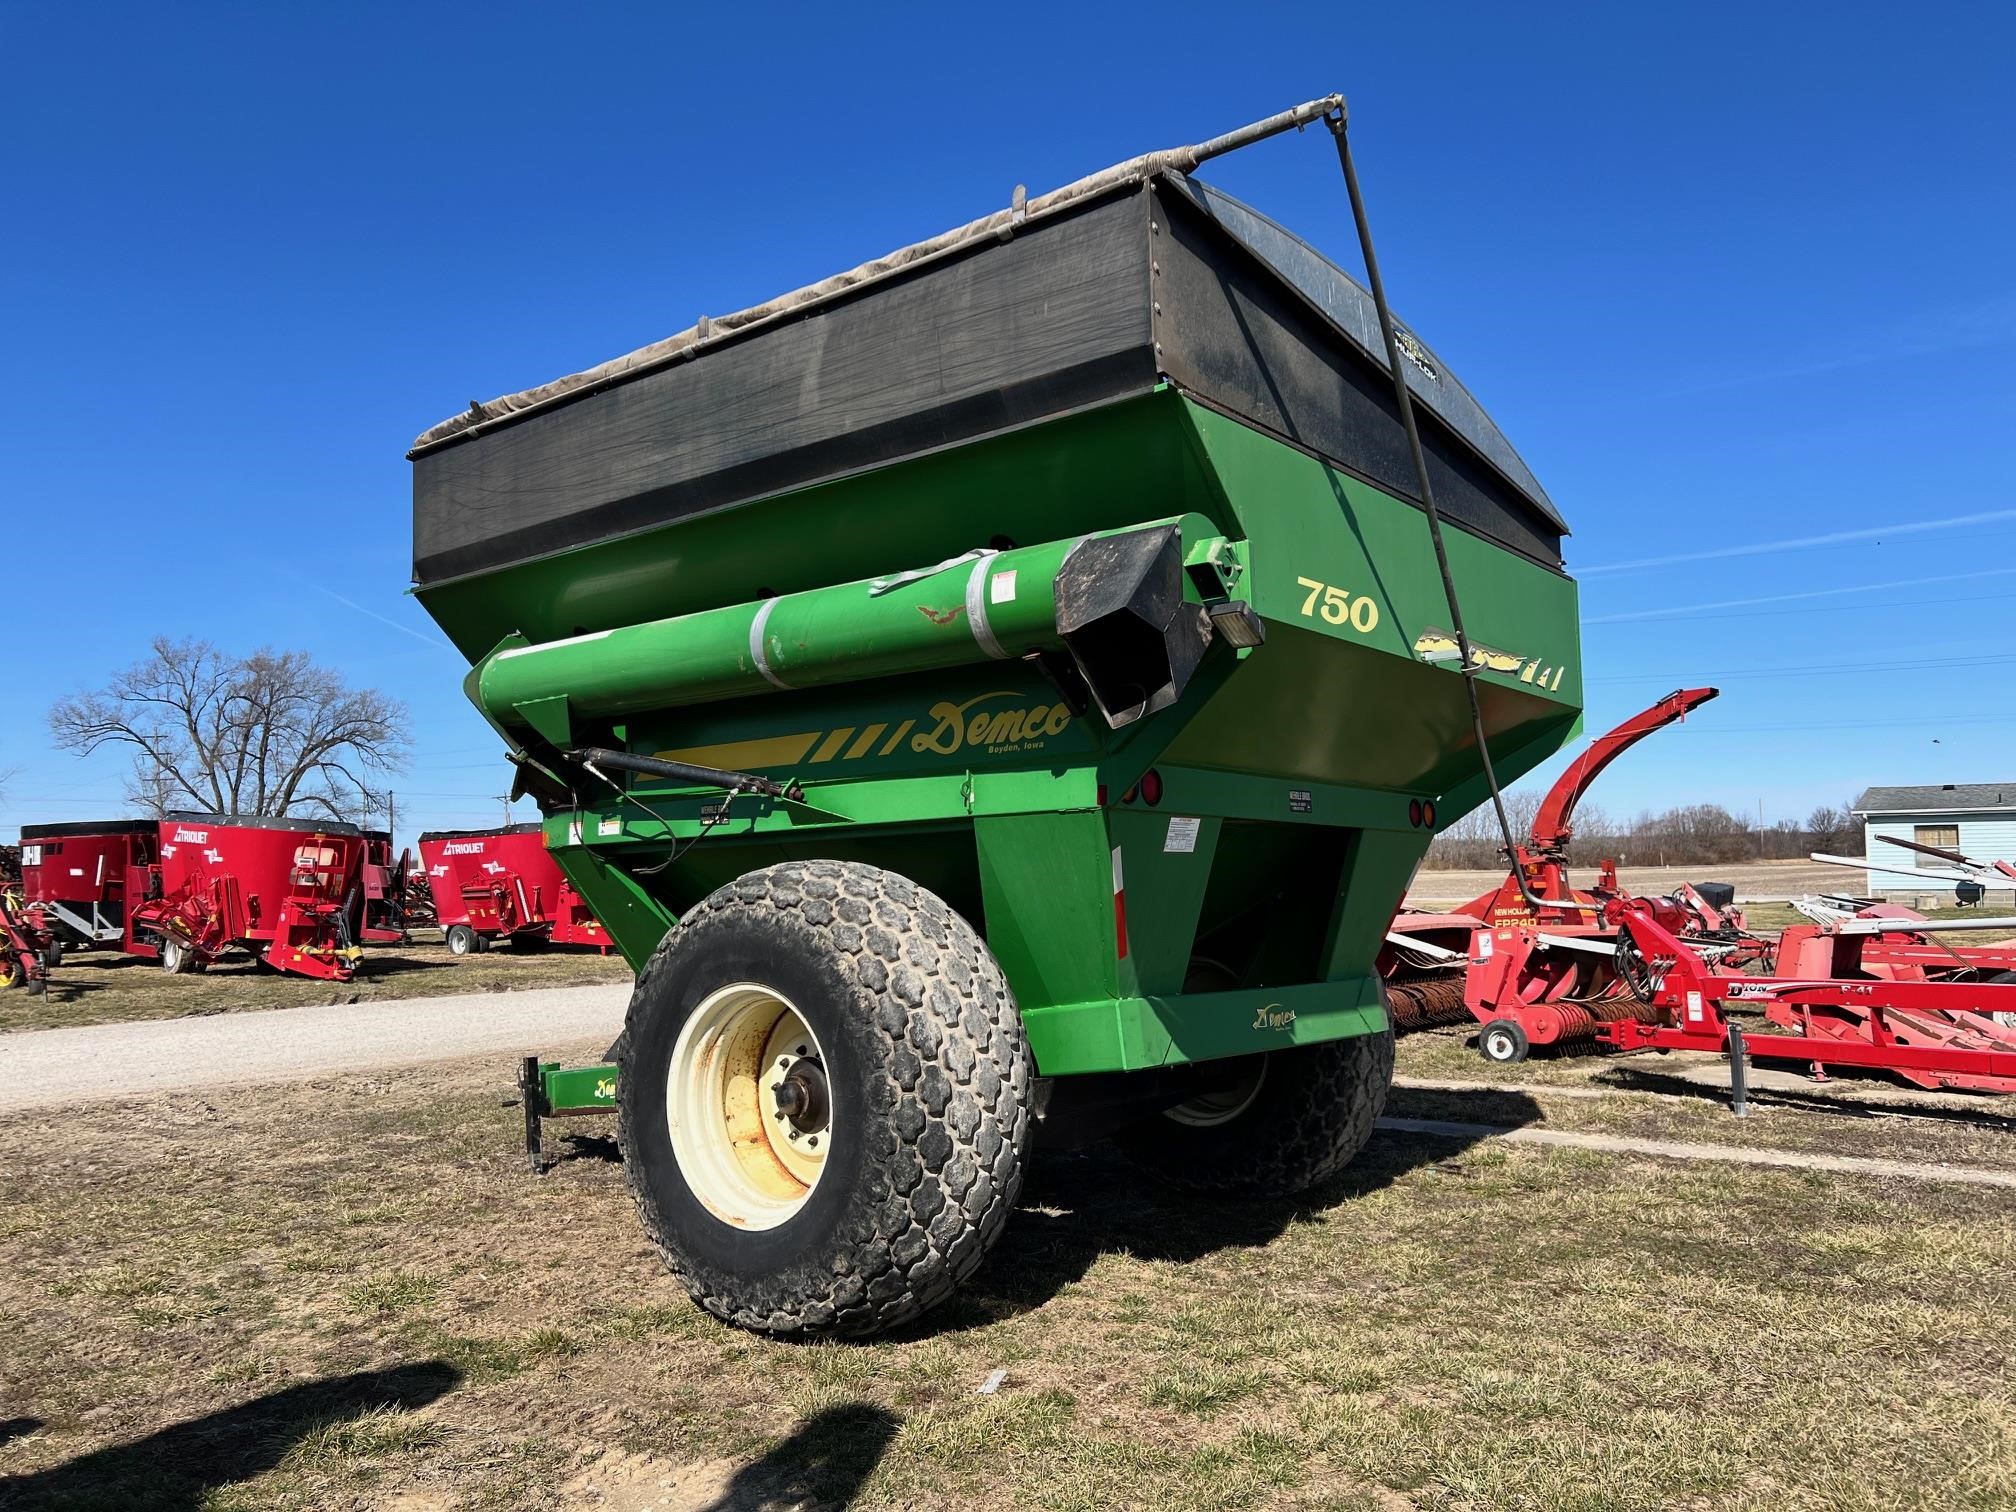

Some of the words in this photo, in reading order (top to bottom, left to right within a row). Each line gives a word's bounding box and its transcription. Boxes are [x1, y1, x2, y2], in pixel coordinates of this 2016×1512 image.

[1297, 576, 1379, 633] 750
[911, 692, 1072, 755] Demco
[988, 743, 1021, 754] Boyden,
[1023, 741, 1045, 750] Iowa
[1494, 908, 1508, 917] NEW
[1494, 917, 1537, 928] FP240
